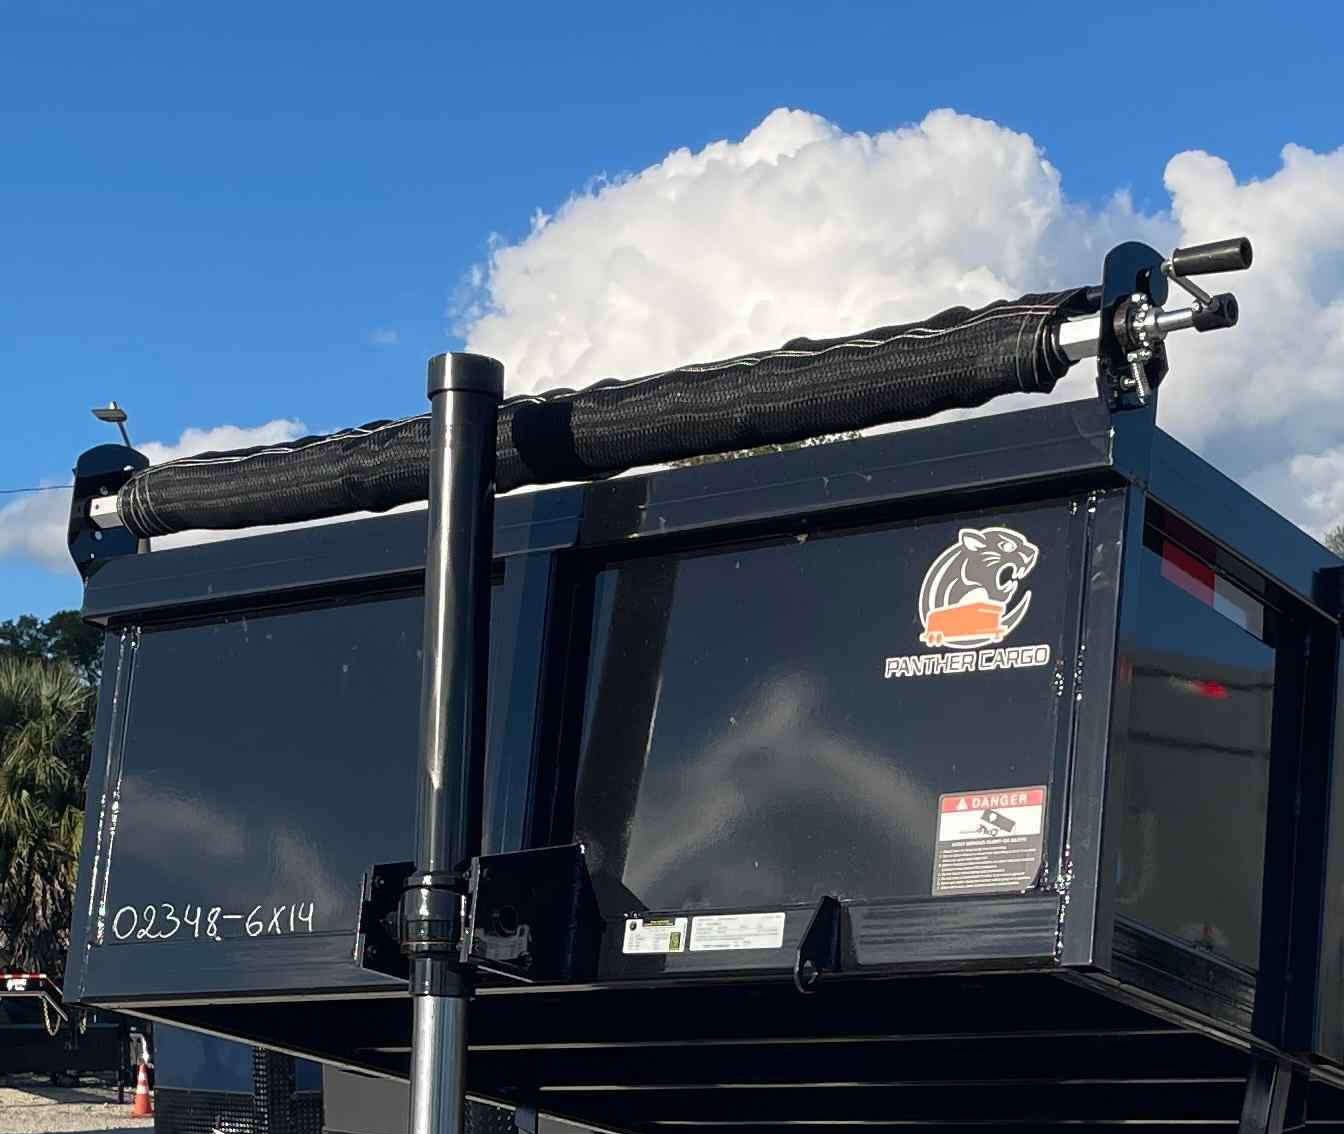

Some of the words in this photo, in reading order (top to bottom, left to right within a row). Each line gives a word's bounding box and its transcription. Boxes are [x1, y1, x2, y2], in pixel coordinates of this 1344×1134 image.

[885, 652, 976, 678] PANTHER
[978, 645, 1050, 670] CARGO
[971, 794, 1028, 809] DANGER
